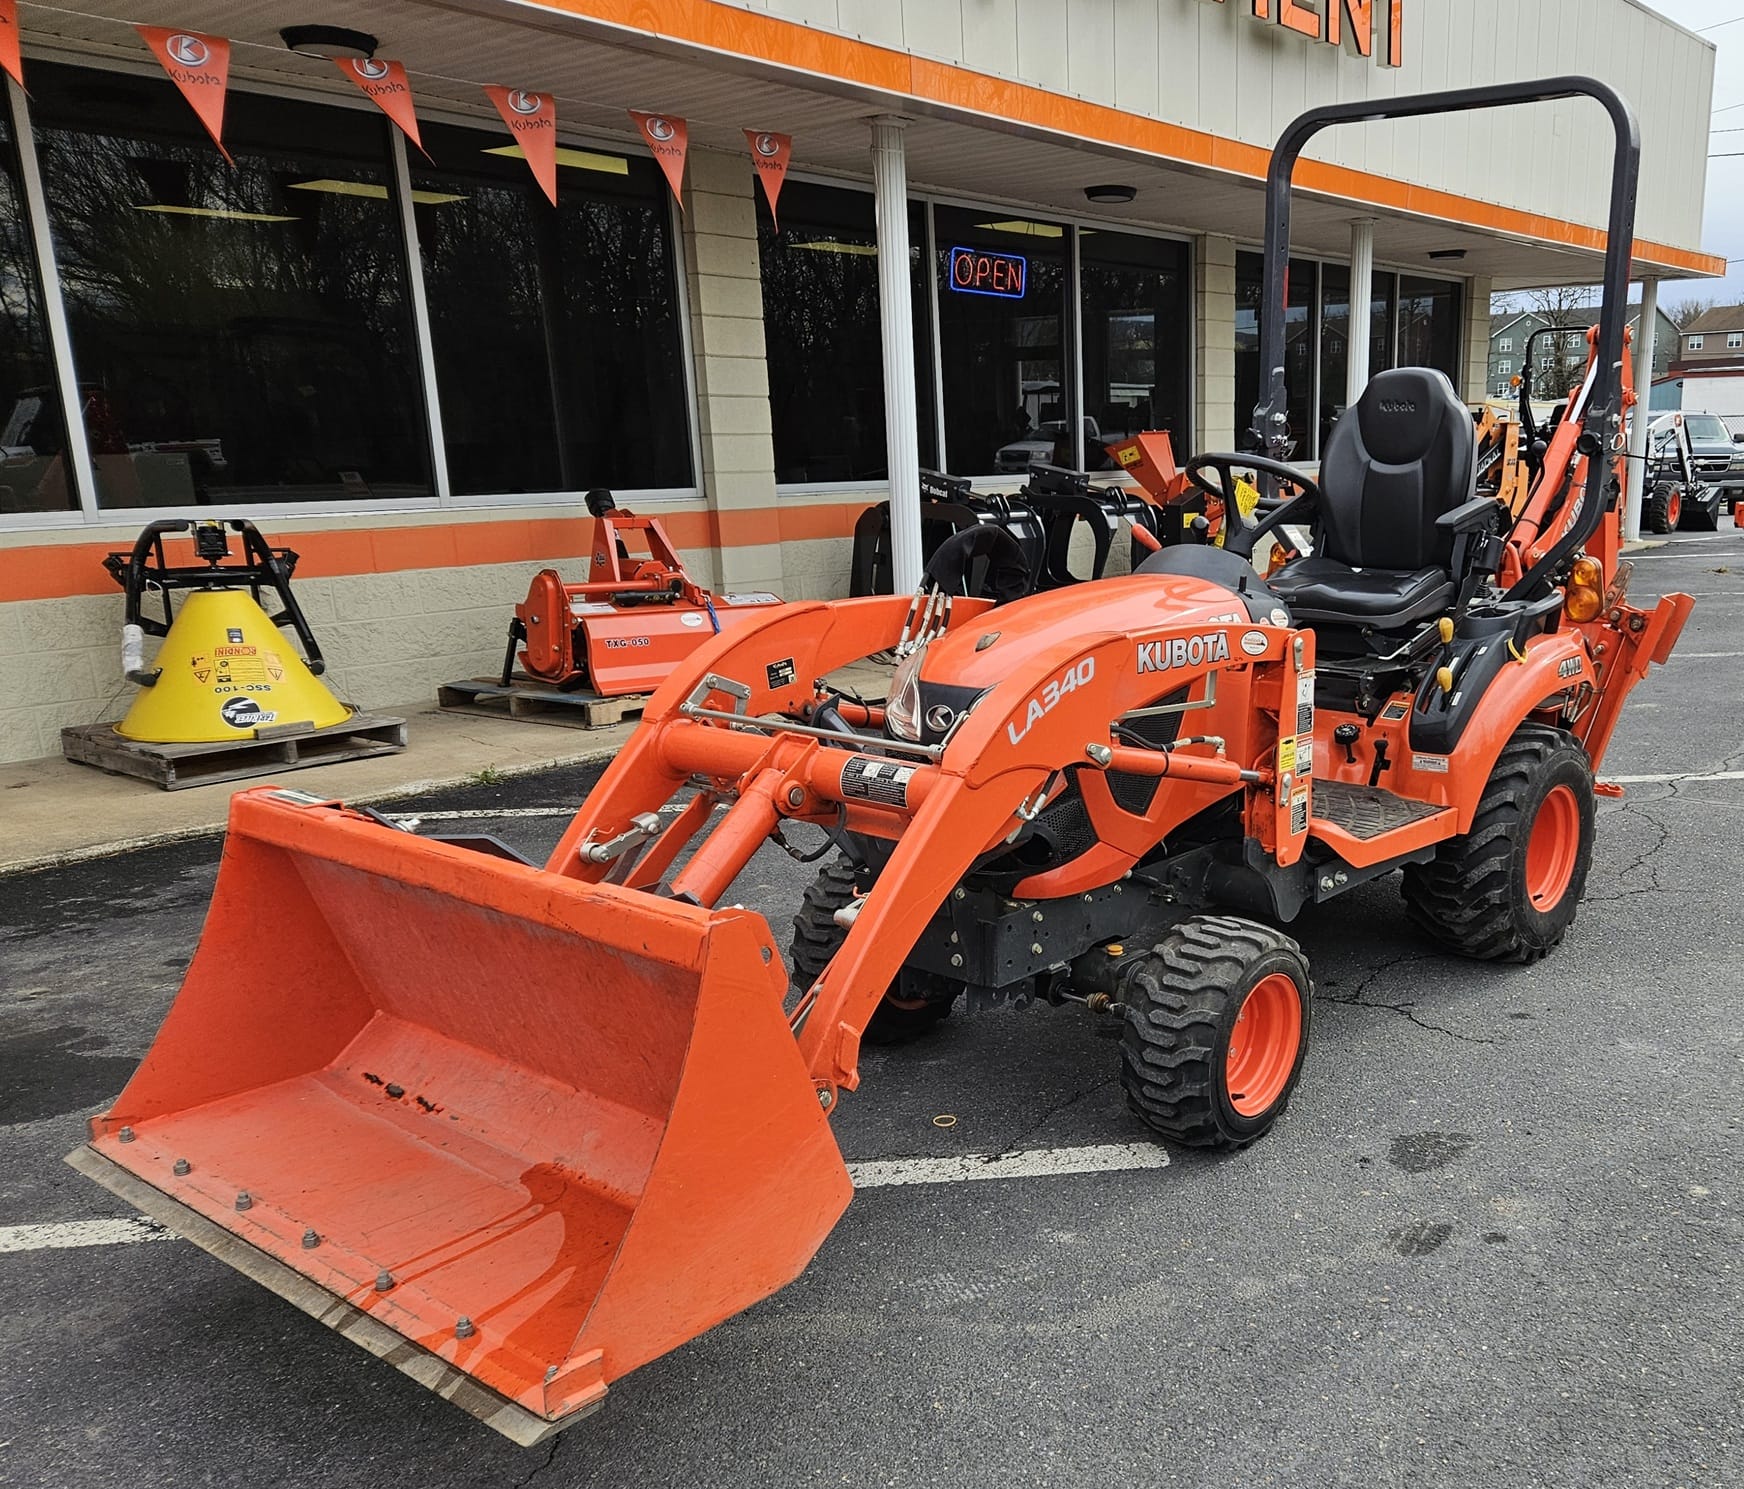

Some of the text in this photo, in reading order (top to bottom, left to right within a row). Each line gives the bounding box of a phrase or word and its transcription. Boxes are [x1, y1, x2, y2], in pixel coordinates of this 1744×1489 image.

[169, 68, 222, 87] Kubota
[362, 81, 406, 96] Kubota
[511, 118, 553, 130] Kubota
[955, 254, 1022, 292] OPEN
[929, 485, 948, 498] Bobcat
[606, 637, 650, 649] TXG-050
[1137, 630, 1231, 675] KUBOTA
[214, 684, 272, 694] SSC-100
[1007, 656, 1095, 745] LA340
